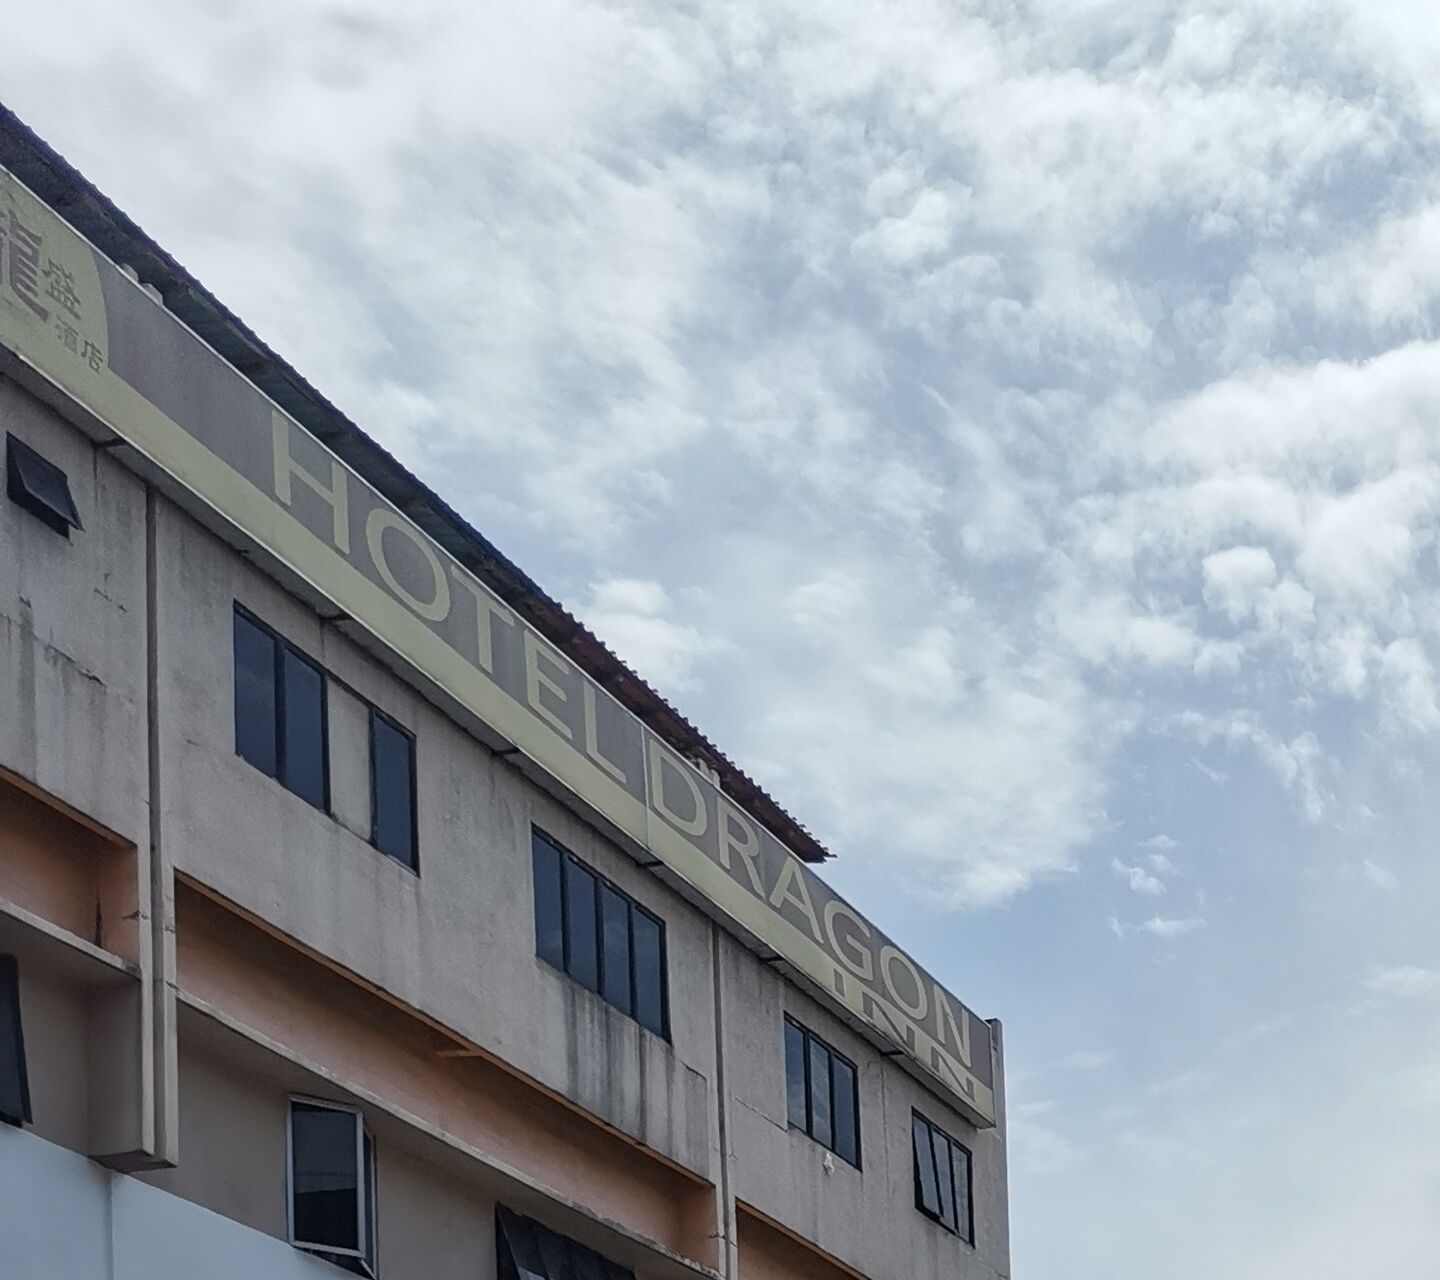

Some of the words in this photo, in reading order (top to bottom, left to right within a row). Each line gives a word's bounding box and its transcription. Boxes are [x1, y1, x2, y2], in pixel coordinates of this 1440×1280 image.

[271, 408, 628, 785] HOTEL
[649, 738, 973, 1068] DRAGON
[832, 967, 977, 1102] INN
